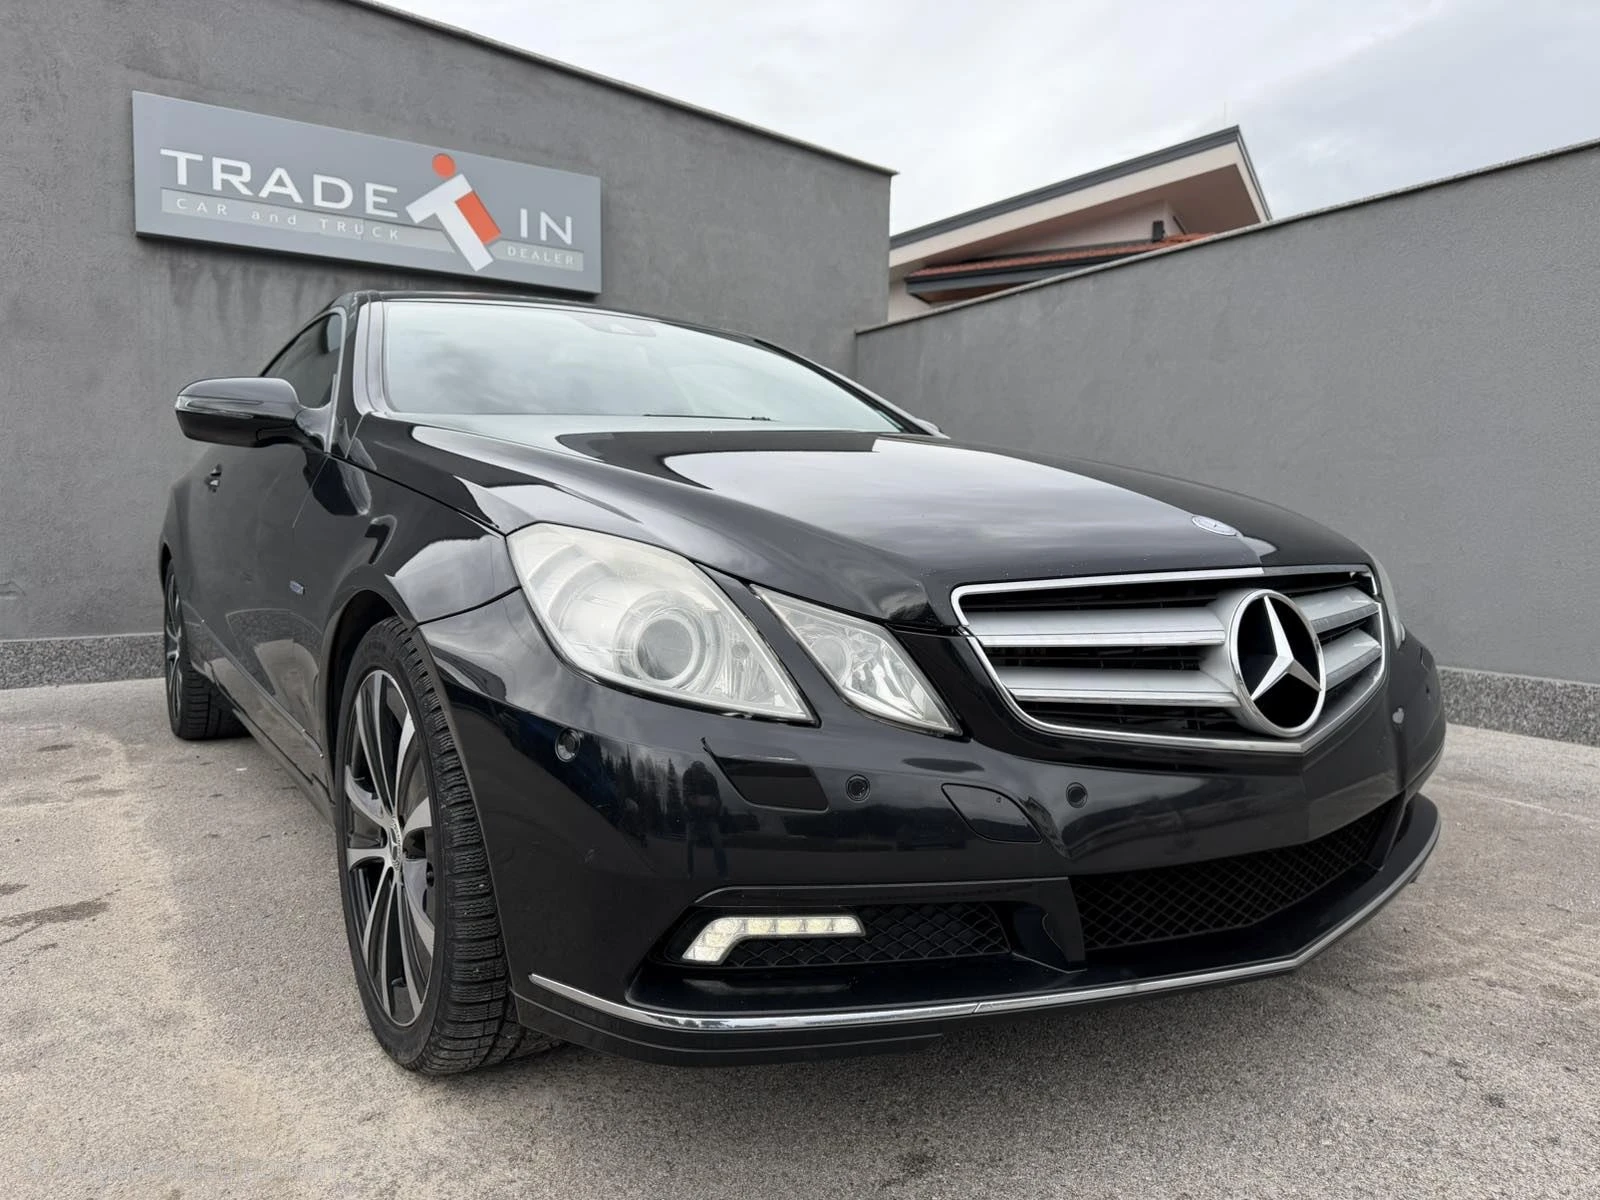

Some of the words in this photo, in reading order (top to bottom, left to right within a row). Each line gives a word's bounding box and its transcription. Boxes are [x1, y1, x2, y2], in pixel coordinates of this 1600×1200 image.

[160, 149, 398, 218] TRADE
[520, 208, 573, 245] IN
[176, 198, 228, 216] CAR
[251, 209, 297, 226] and
[319, 218, 399, 240] TRUCK
[507, 245, 575, 266] DEALER
